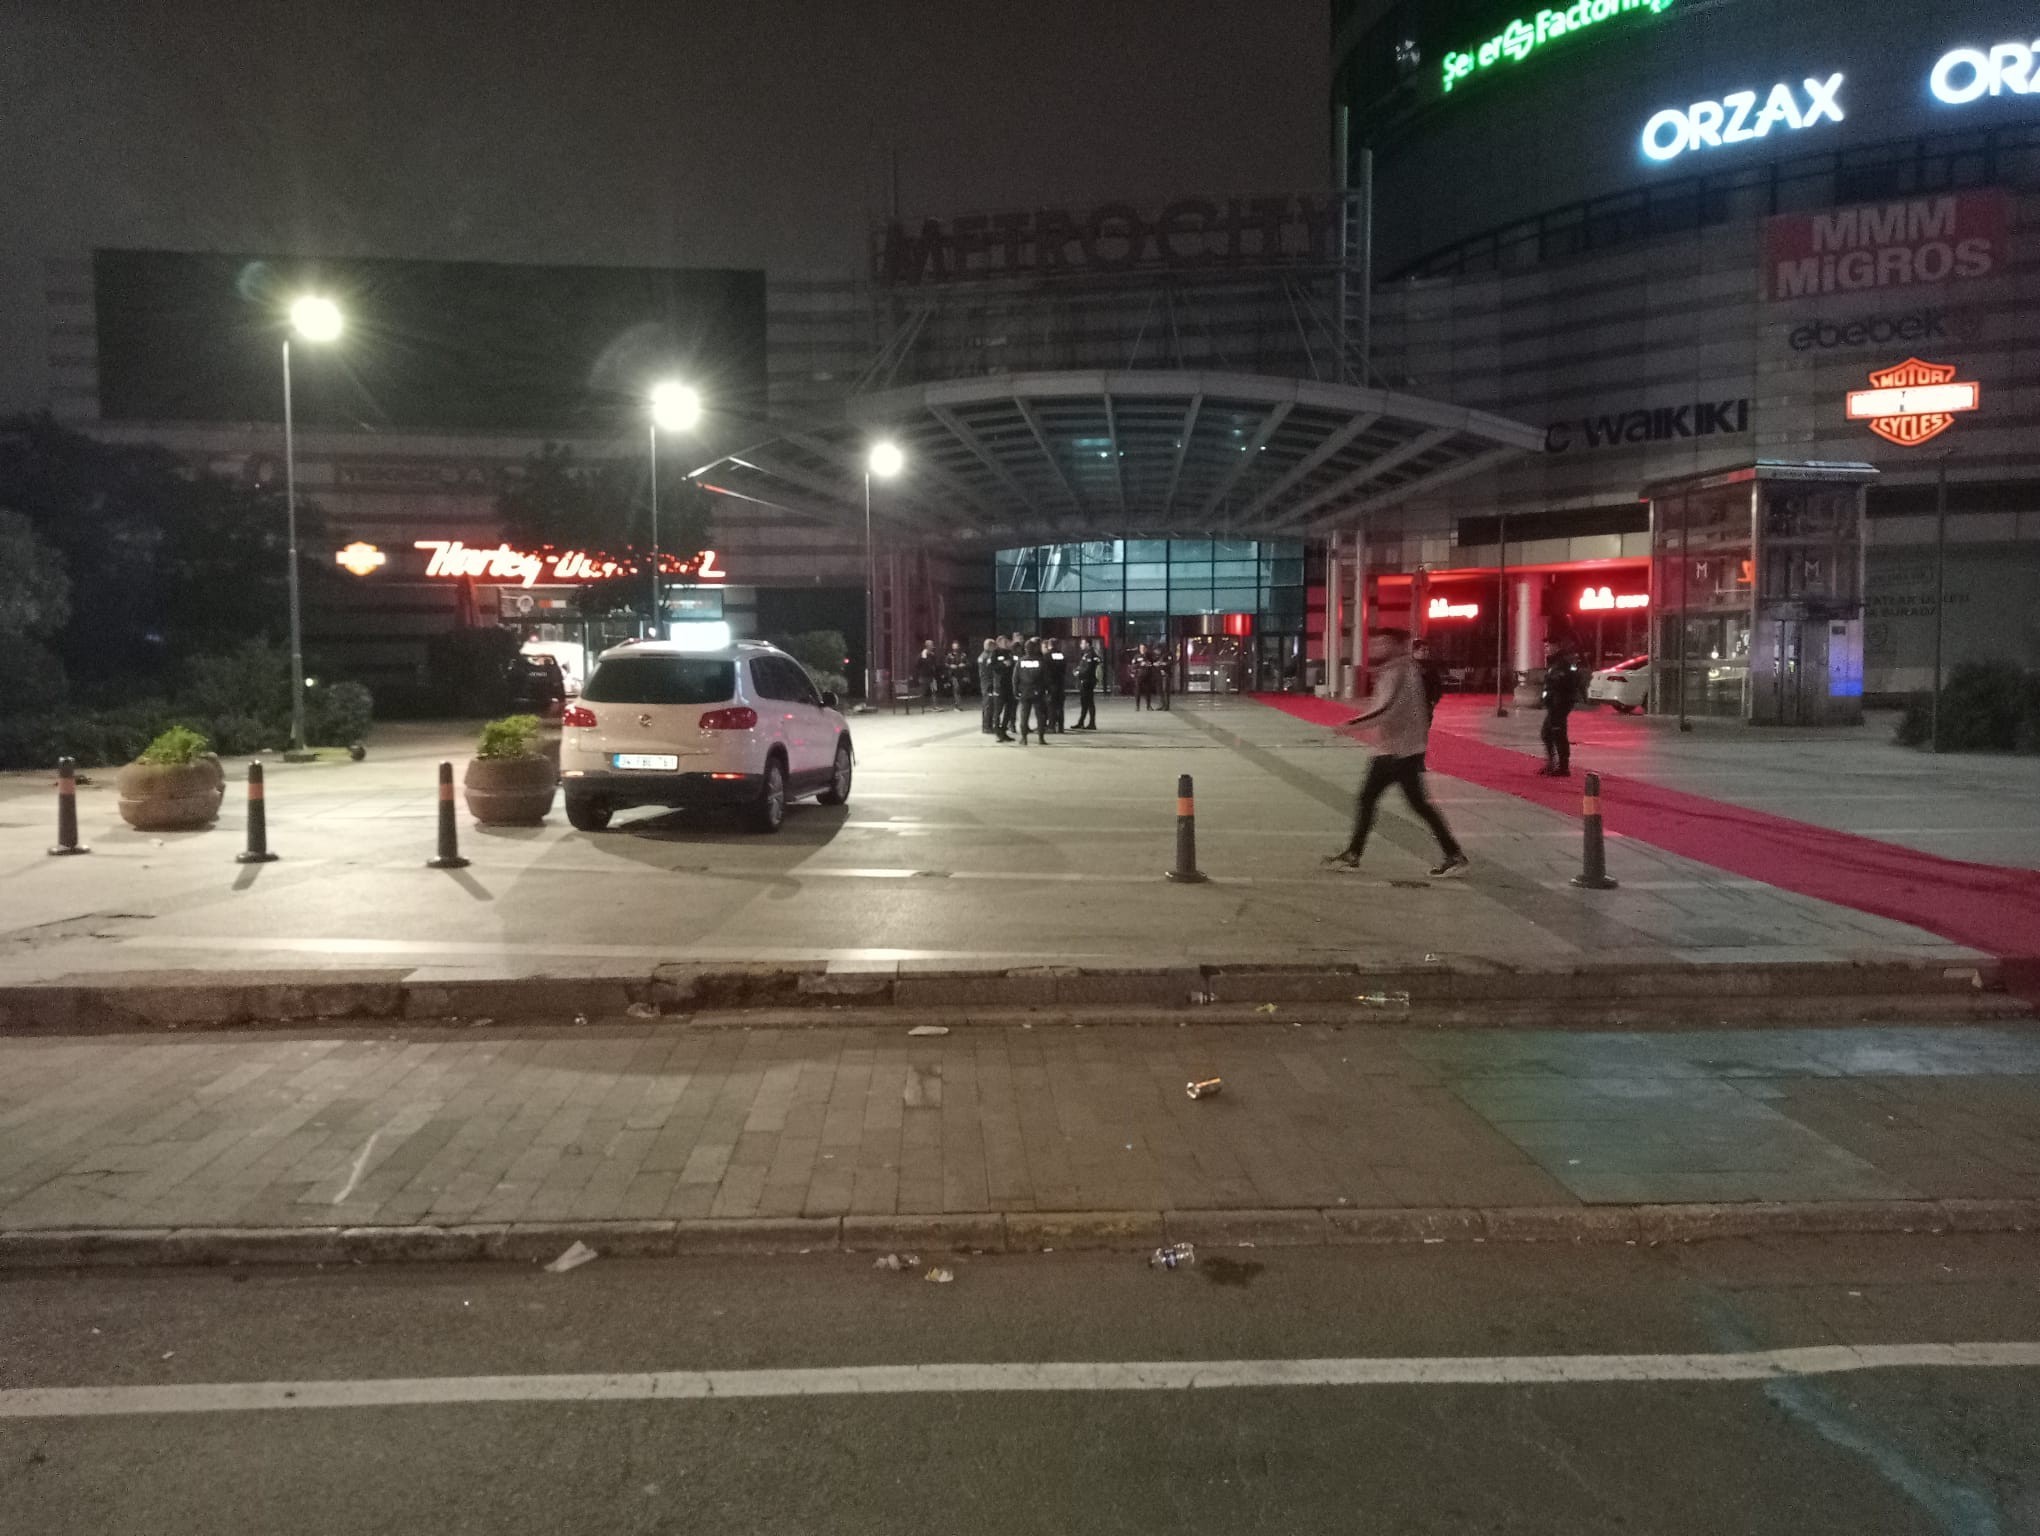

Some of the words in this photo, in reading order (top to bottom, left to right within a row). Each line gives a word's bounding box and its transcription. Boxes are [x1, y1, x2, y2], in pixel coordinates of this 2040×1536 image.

[1443, 36, 1502, 92] Şeer
[1642, 73, 1844, 160] ORZAX
[1813, 198, 1956, 250] MMM
[1789, 307, 1945, 350] ebebek
[1879, 368, 1945, 387] MOTOR
[1879, 414, 1944, 440] CYCLES
